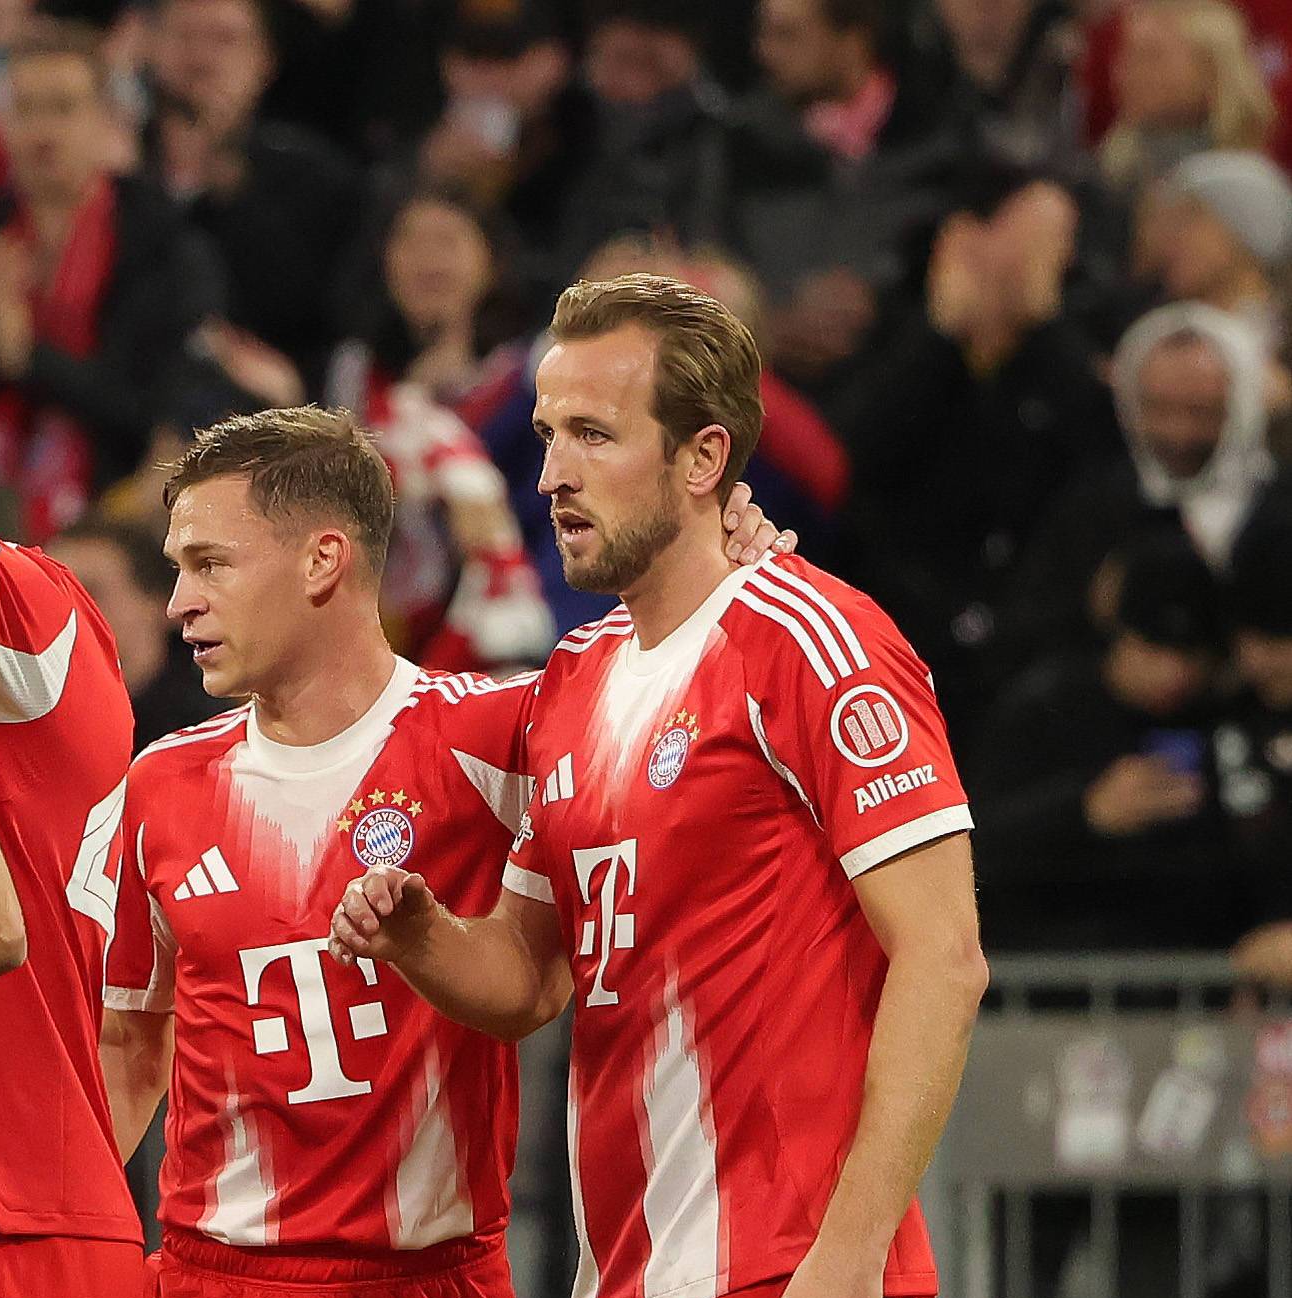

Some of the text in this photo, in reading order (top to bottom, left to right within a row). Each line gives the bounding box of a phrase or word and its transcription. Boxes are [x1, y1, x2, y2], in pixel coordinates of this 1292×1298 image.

[853, 764, 938, 815] Allianz
[356, 812, 408, 840] FC BAYERN
[571, 839, 638, 1007] T
